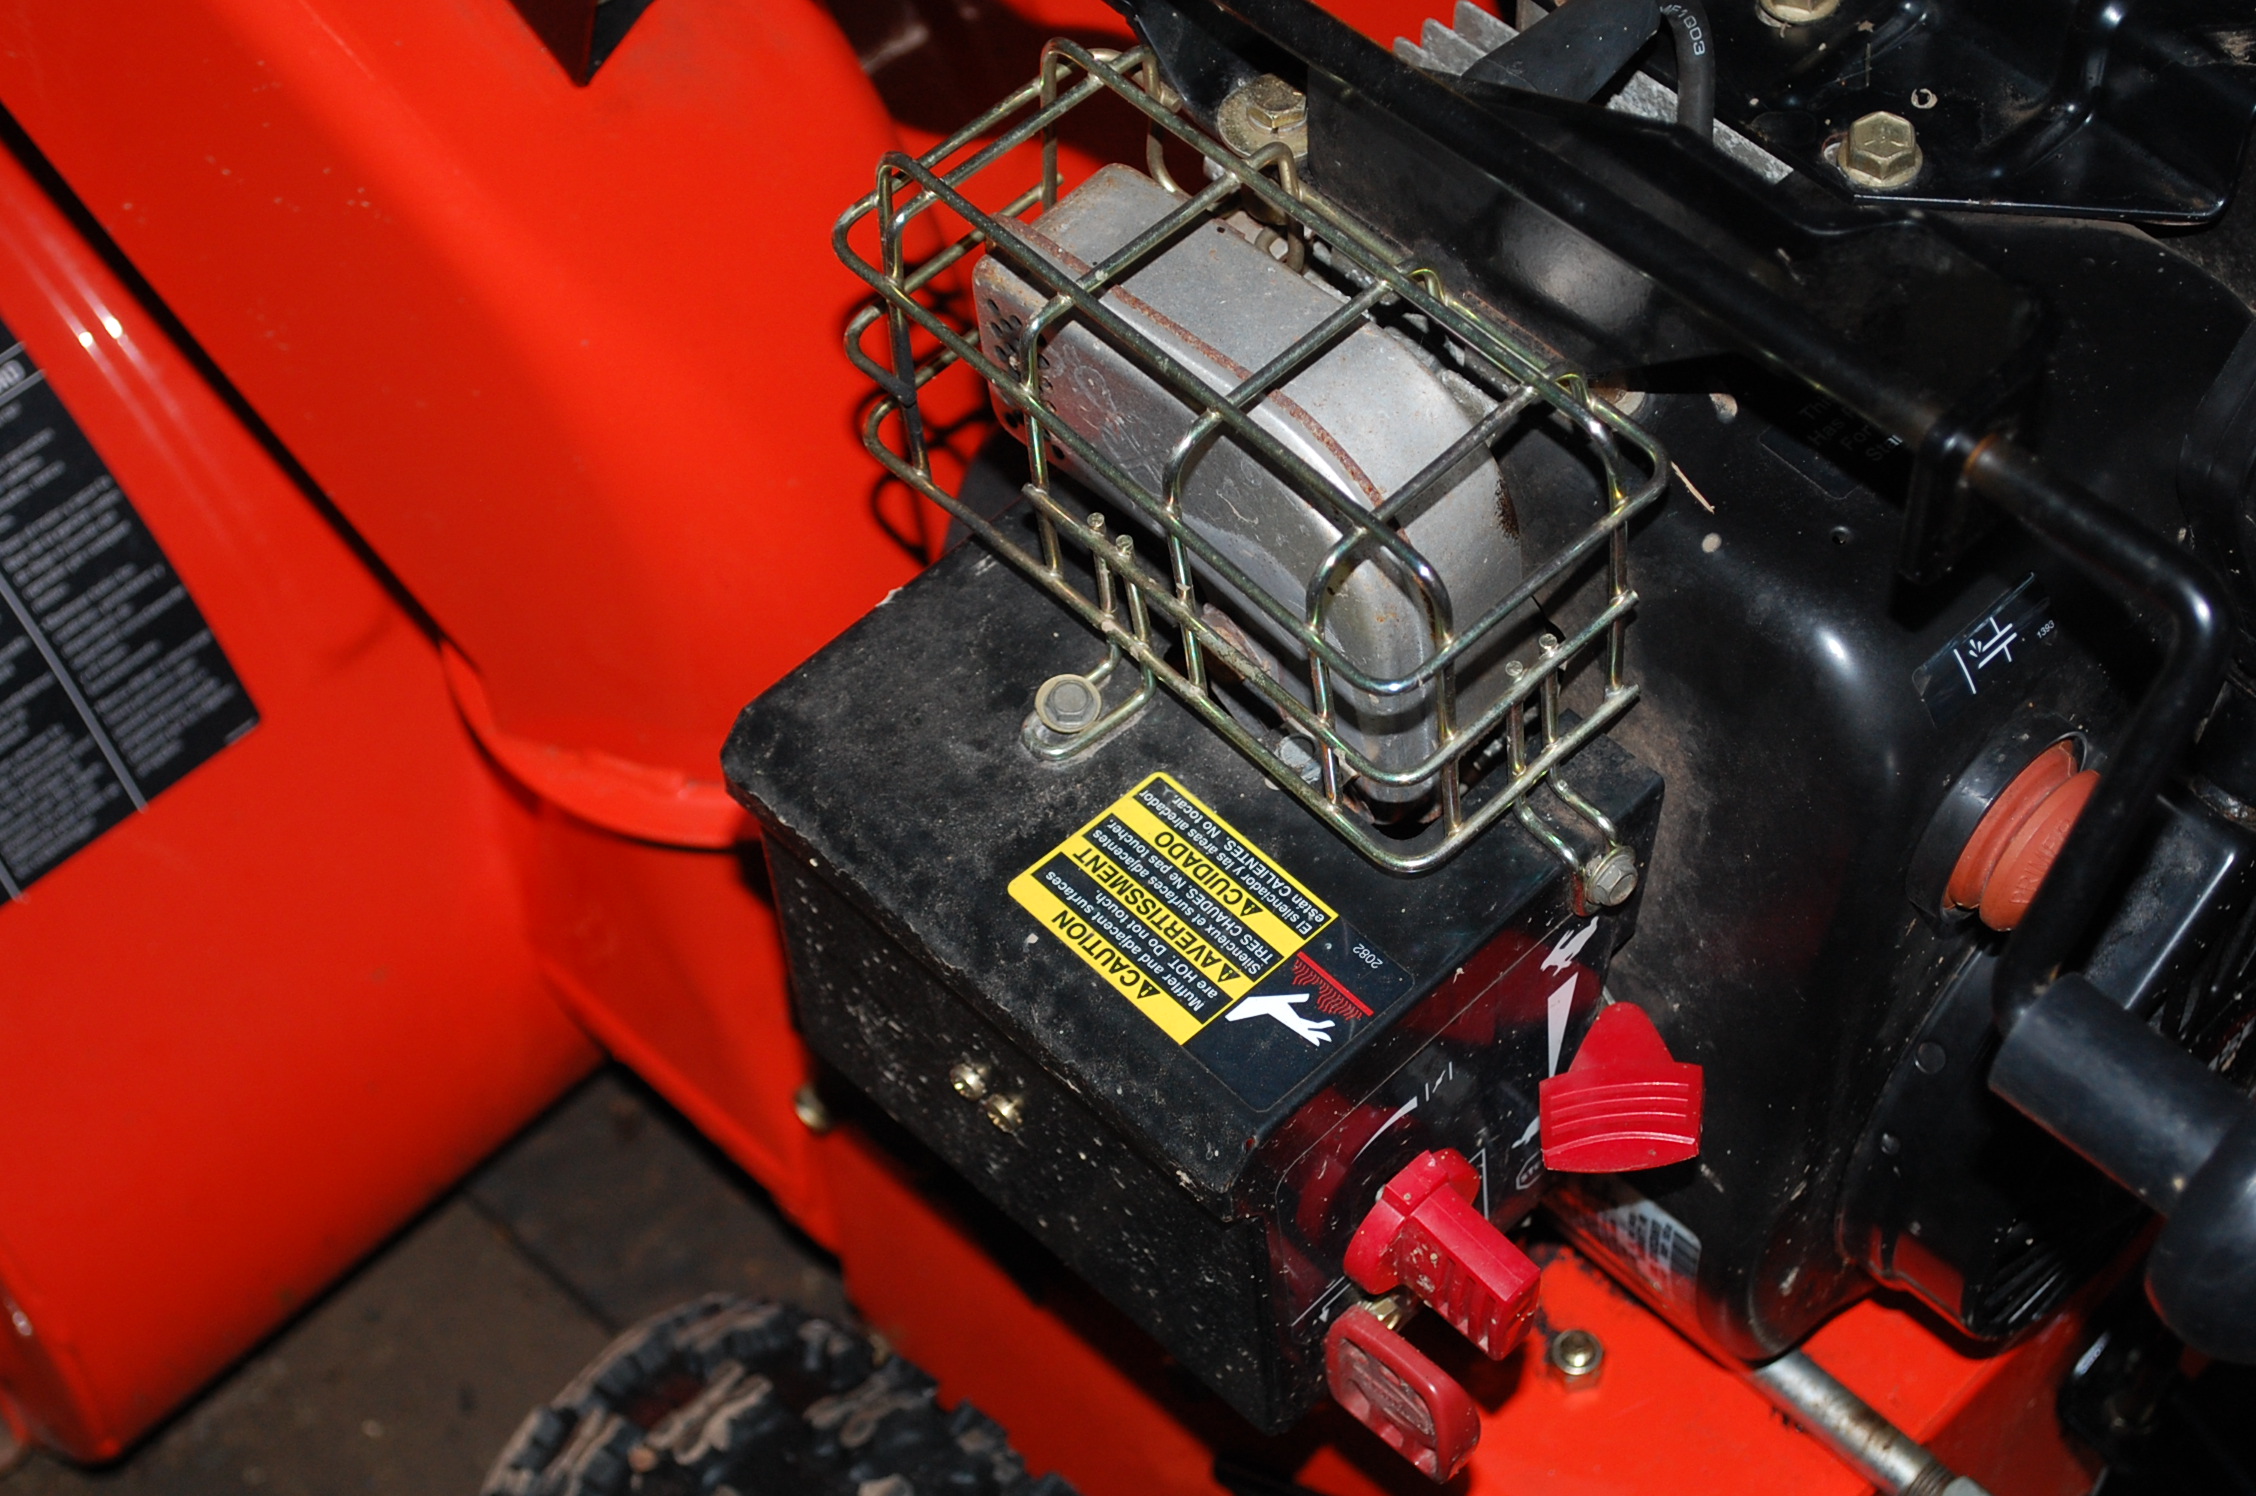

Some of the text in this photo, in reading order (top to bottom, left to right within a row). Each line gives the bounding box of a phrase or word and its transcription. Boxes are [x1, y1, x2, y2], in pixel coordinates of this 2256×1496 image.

[2035, 619, 2056, 639] 1393
[1071, 844, 1222, 972] AVERTISSMENT
[1088, 827, 1262, 975] Silencieux et surfaces adjacentes
[1102, 818, 1275, 963] TRES CHAUDES. Ne pas toucher.
[1137, 788, 1313, 934] El silenciador y las áreas alredador
[1151, 828, 1245, 907] CUIDADO
[1168, 793, 1326, 924] están CALIENTES. No tocar.
[1041, 870, 1205, 1011] Muffler and adjacent surfaces
[1050, 908, 1143, 989] CAUTION
[1088, 889, 1219, 999] are HOT. Do not touch.
[1351, 942, 1384, 969] 2082
